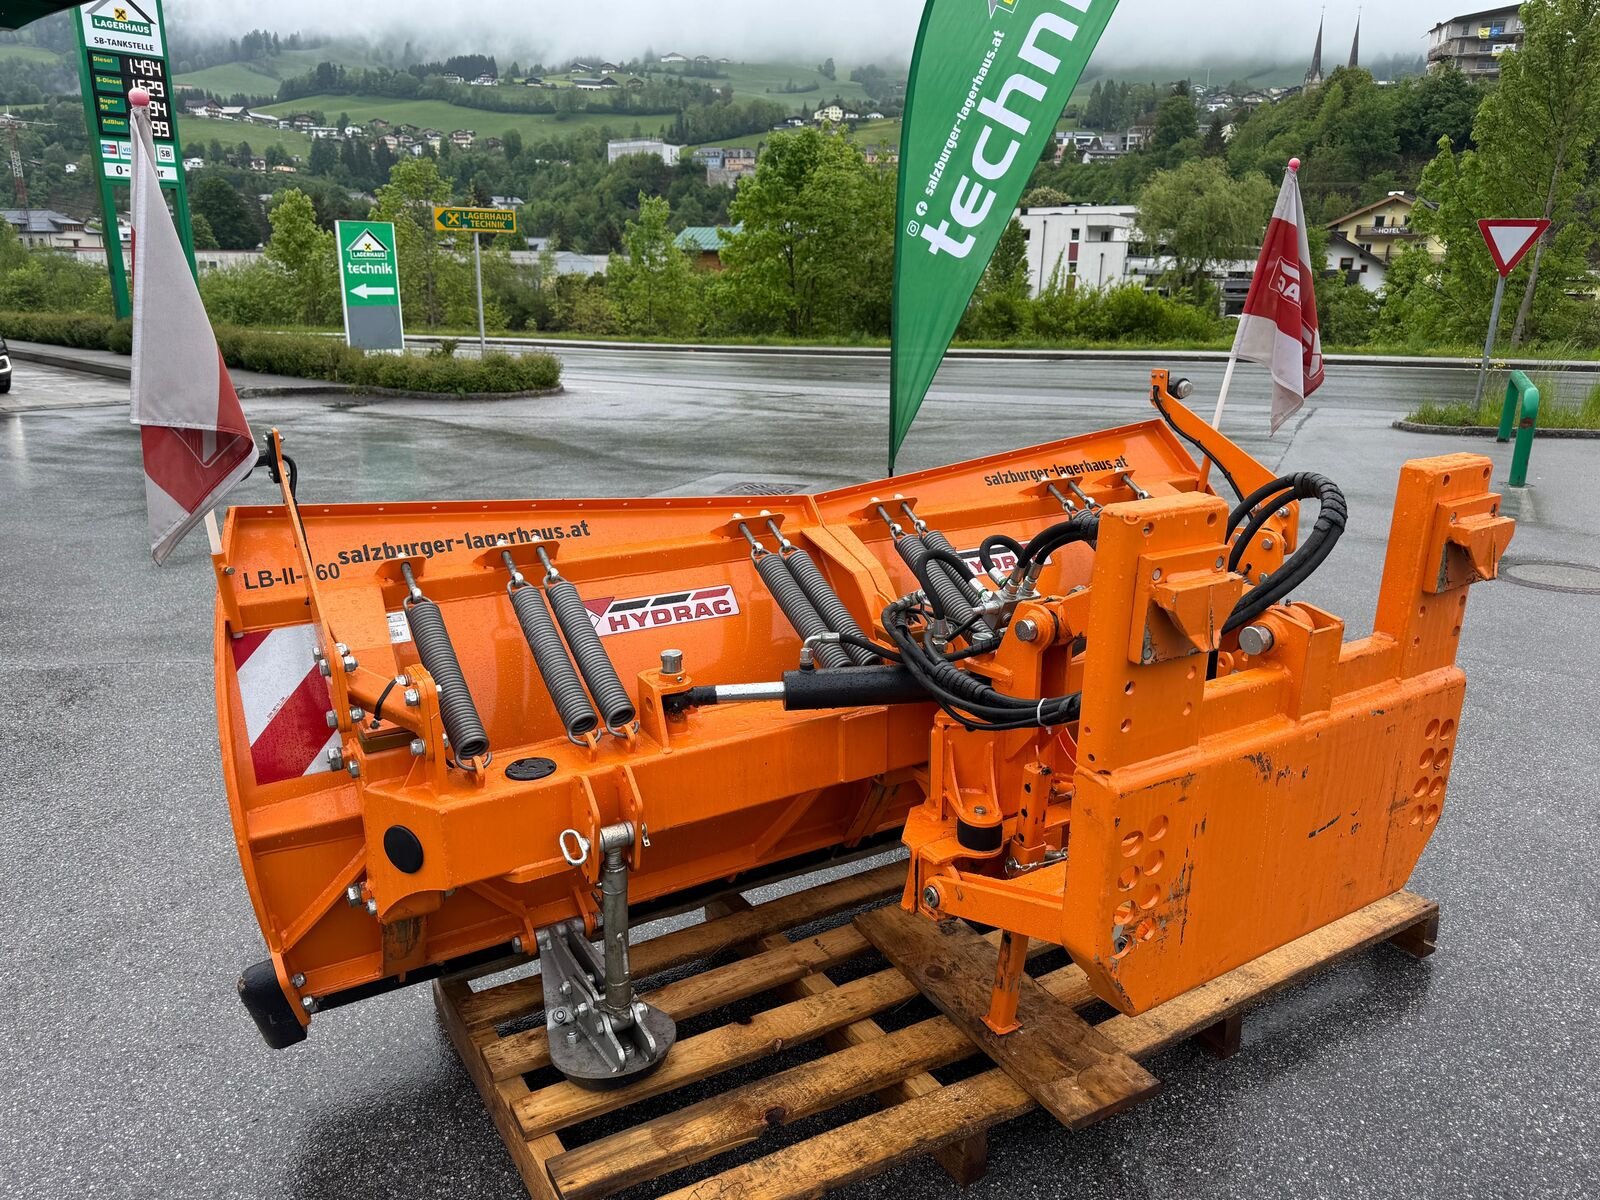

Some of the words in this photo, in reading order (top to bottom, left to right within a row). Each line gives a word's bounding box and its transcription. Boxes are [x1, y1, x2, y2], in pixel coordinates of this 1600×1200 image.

[94, 18, 150, 34] LAGERHAUS
[94, 37, 154, 51] SB-TANKSTELLE
[129, 58, 162, 77] 1.494
[96, 77, 122, 85] S-Diesel
[925, 29, 1005, 196] salzburger-lagerhaus.at
[463, 212, 513, 221] LAGERHAUS
[470, 220, 506, 229] TECHNIK
[347, 262, 393, 275] technik
[337, 519, 591, 566] salzburger-lagerhaus.at
[243, 562, 341, 590] LB-II-60
[608, 599, 732, 632] HYDRAC
